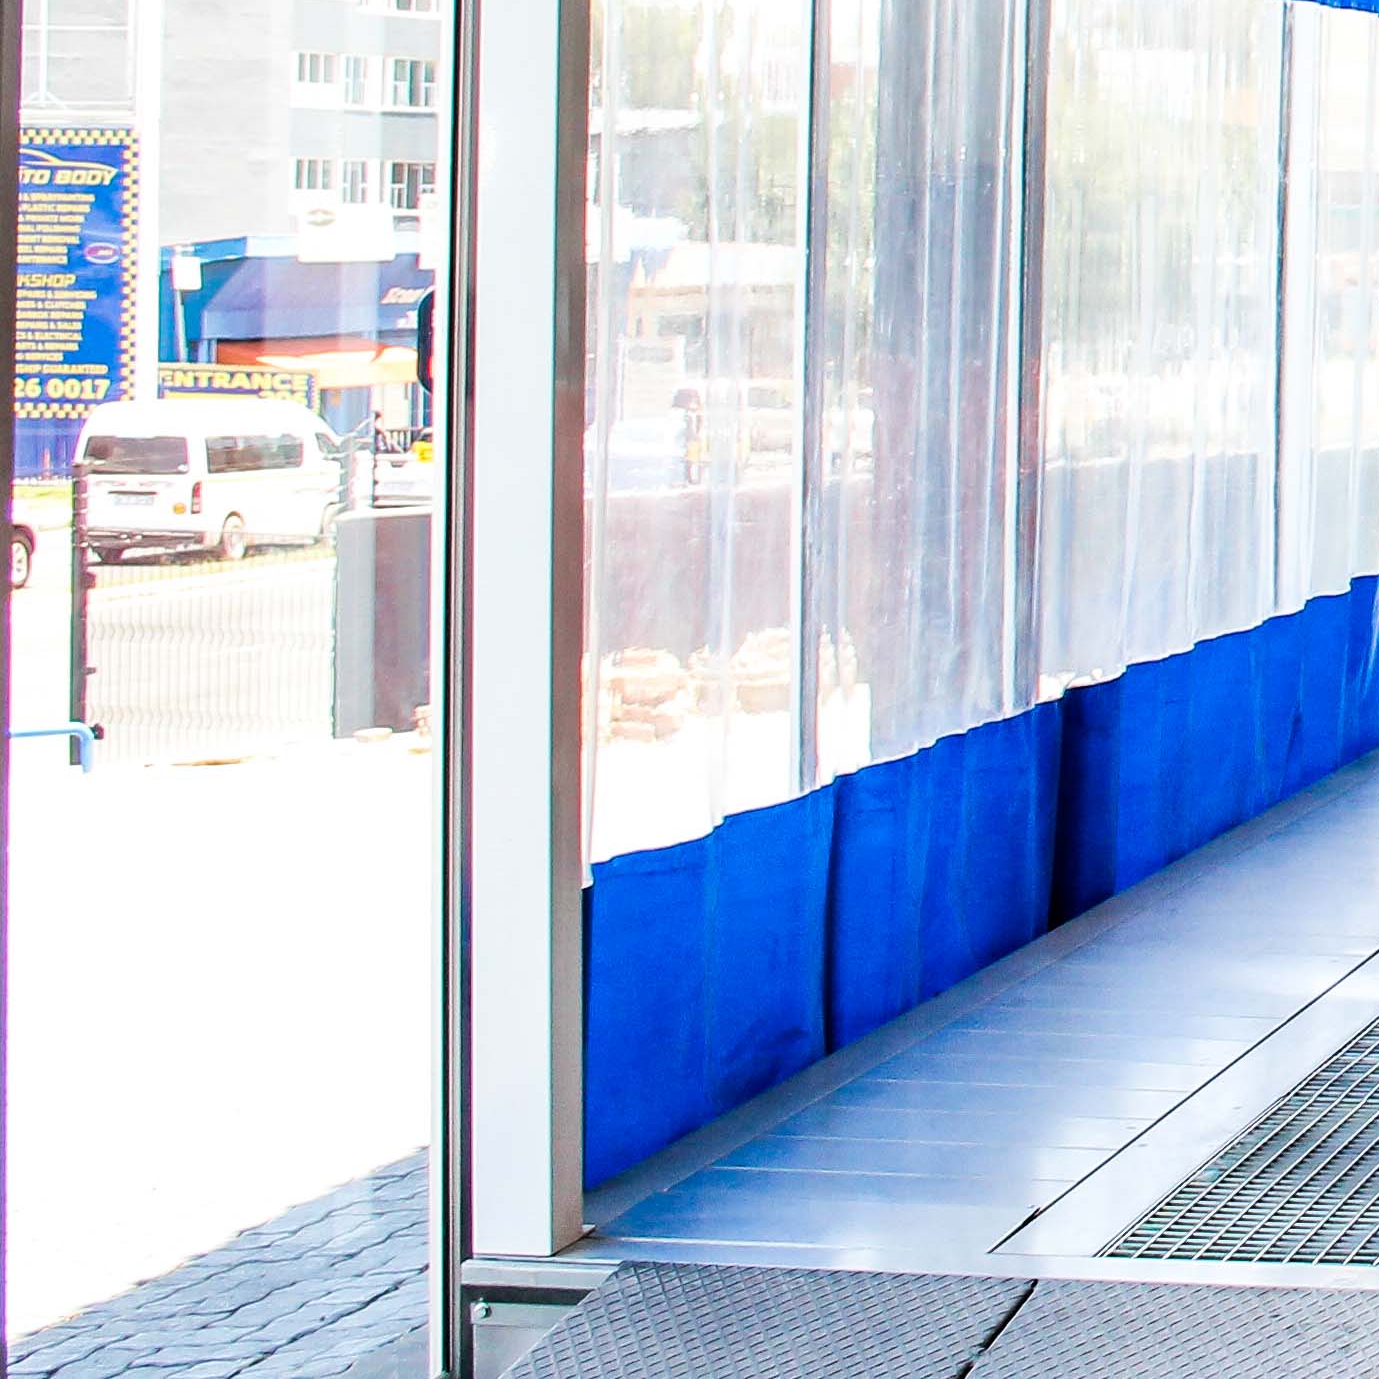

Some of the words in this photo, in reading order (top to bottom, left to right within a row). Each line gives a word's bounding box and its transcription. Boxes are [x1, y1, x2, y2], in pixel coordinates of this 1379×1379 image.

[54, 169, 117, 186] BODY
[46, 378, 111, 399] 0017
[160, 371, 308, 390] ENTRANCE
